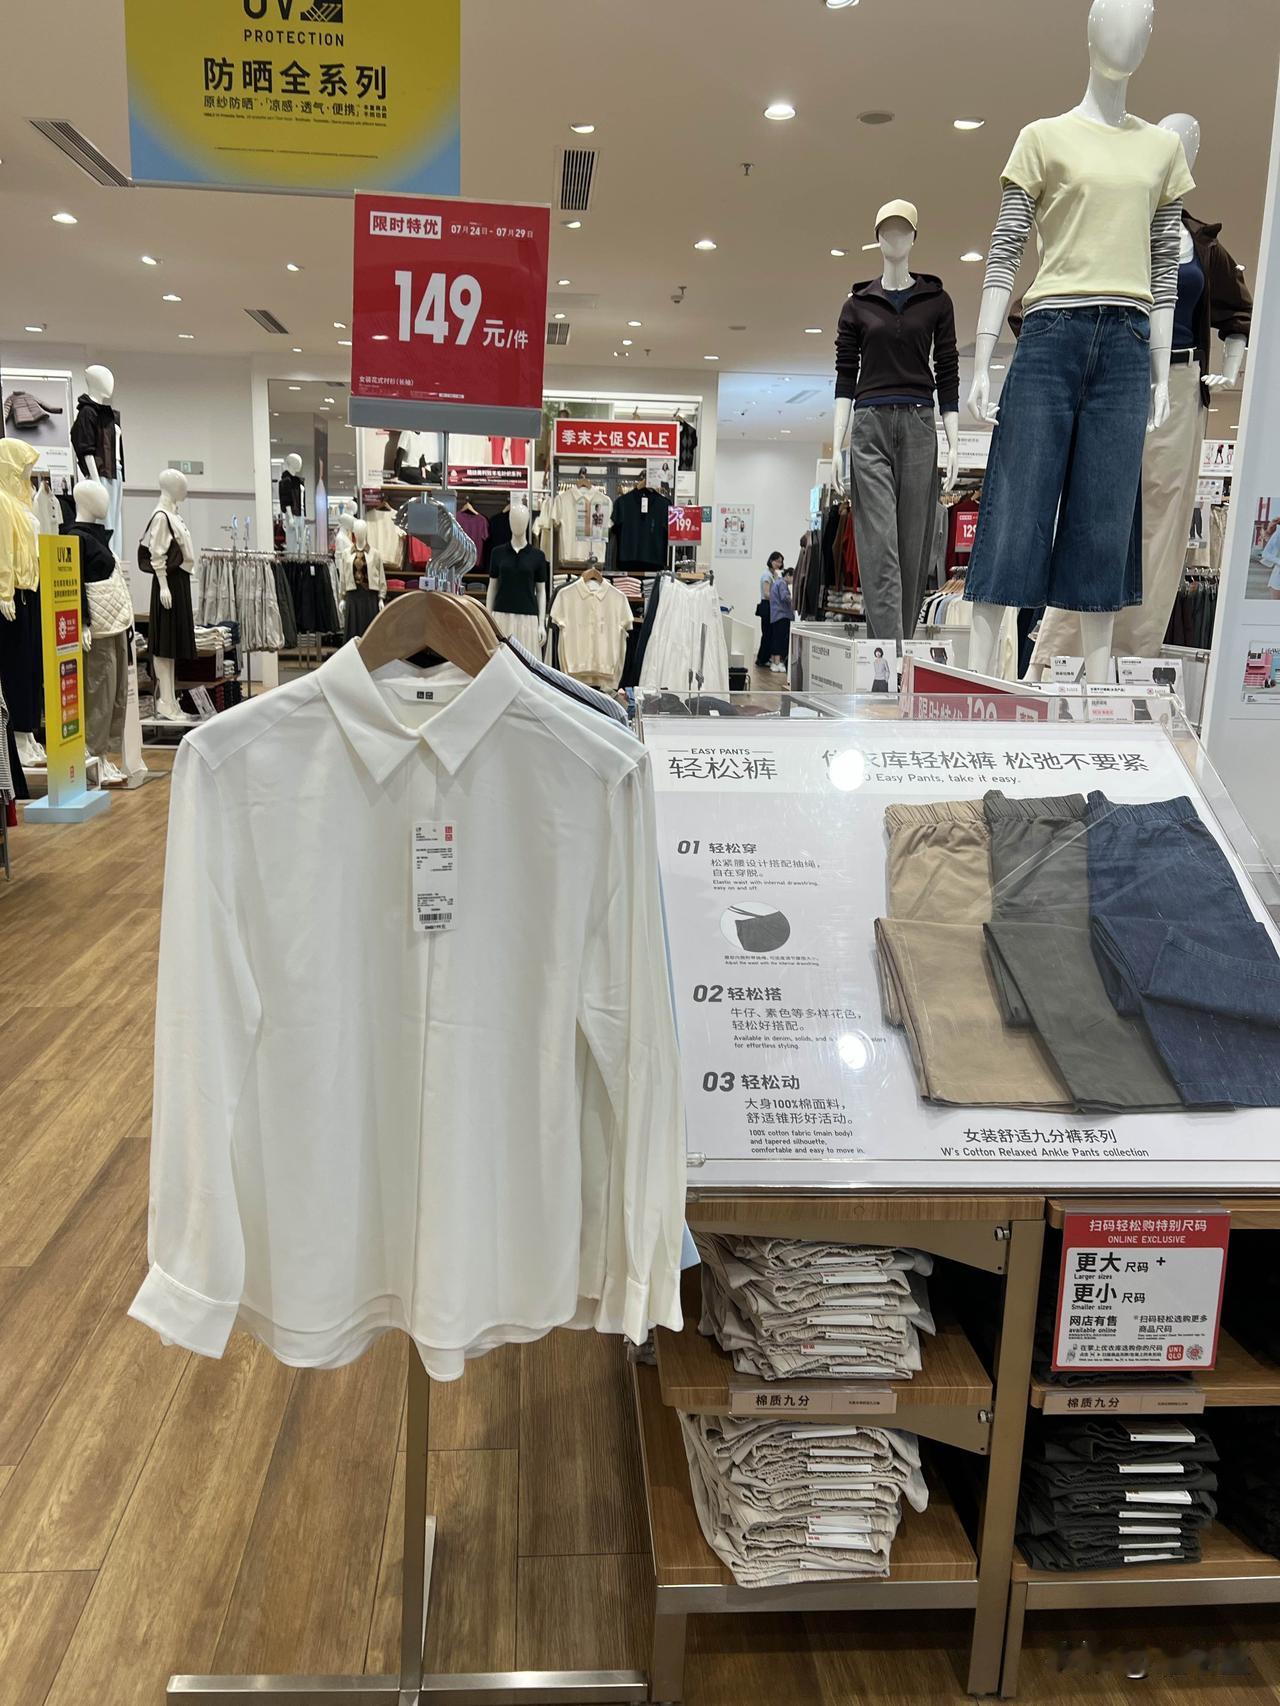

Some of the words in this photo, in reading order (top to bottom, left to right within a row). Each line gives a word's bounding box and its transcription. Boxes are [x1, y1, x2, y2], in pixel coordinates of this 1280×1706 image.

[244, 29, 344, 47] PROTECTION
[204, 57, 387, 100] 防晒全系列
[373, 215, 439, 235] 限时特优
[395, 270, 482, 345] 149
[561, 429, 624, 447] 季末大促
[627, 431, 670, 449] SALE
[676, 518, 692, 531] 199
[719, 748, 750, 756] PANTS
[668, 756, 778, 780] 轻松裤
[1005, 752, 1150, 772] 松弛不要紧
[876, 774, 903, 783] Easy
[908, 774, 944, 783] Pants,
[949, 774, 974, 783] take
[979, 774, 988, 783] it
[677, 840, 700, 854] 01
[708, 842, 757, 854] 轻松穿
[693, 984, 723, 1003] 02
[727, 986, 782, 1001] 轻松搭
[732, 1020, 805, 1031] 轻松好搭配。
[702, 1071, 735, 1092] 03
[741, 1074, 800, 1090] 轻松动
[746, 1112, 853, 1124] 舒适锥形好活动。
[963, 1128, 1118, 1144] 女装舒适九分裤系列
[940, 1147, 959, 1156] W's
[963, 1147, 996, 1156] Cotton
[998, 1147, 1037, 1156] Relaxed
[1041, 1147, 1069, 1157] Ankle
[1073, 1148, 1100, 1157] Pants
[1103, 1148, 1150, 1158] collection
[1089, 1219, 1208, 1232] 扫码轻松购特别尺码
[1108, 1235, 1138, 1244] ONLINE
[1141, 1235, 1186, 1244] EXCLUSIVE
[1075, 1252, 1122, 1273] 更大
[1124, 1262, 1149, 1273] 尺码
[1072, 1283, 1117, 1304] 更小
[1121, 1293, 1146, 1304] 尺码
[1069, 1315, 1118, 1326] 网店有售
[1139, 1325, 1172, 1333] 商品尺码
[756, 1395, 810, 1406] 棉质九分
[1067, 1397, 1120, 1409] 棉质九分
